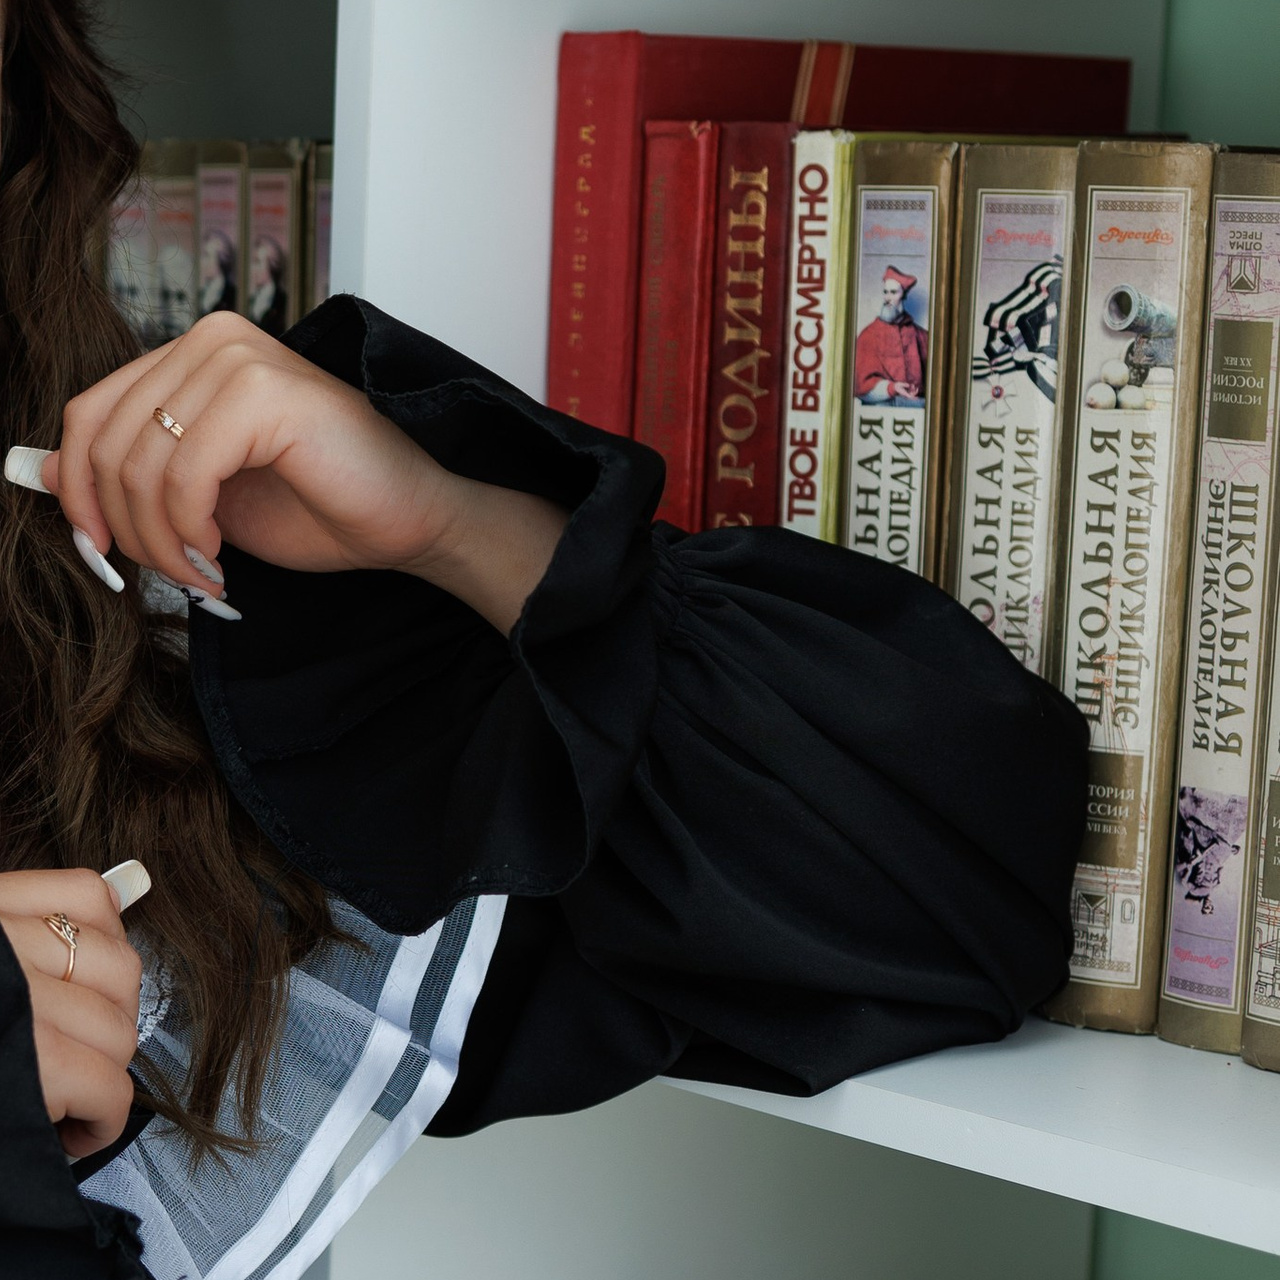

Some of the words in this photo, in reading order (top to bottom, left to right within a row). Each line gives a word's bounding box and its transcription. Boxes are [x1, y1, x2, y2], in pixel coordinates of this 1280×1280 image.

[791, 163, 829, 412] БЕССМЕРТНО
[1229, 230, 1263, 240] ПРЕСС
[1229, 240, 1263, 251] ОЛМА
[717, 165, 771, 488] РОДИНЫ
[1212, 373, 1265, 389] РОССИИ
[1223, 355, 1238, 366] ВЕК
[1213, 391, 1262, 406] ИСТОРИЯ
[788, 427, 819, 523] ТВОЕ
[854, 417, 884, 558] ЬНАЯ
[1075, 427, 1122, 725] ШКОЛЬНАЯ
[1112, 430, 1159, 730] ЭНЦИКЛОПЕДИЯ
[1192, 479, 1227, 752] ЭНЦИКЛОПЕДИЯ
[1213, 481, 1260, 757] ШКОЛЬНАЯ
